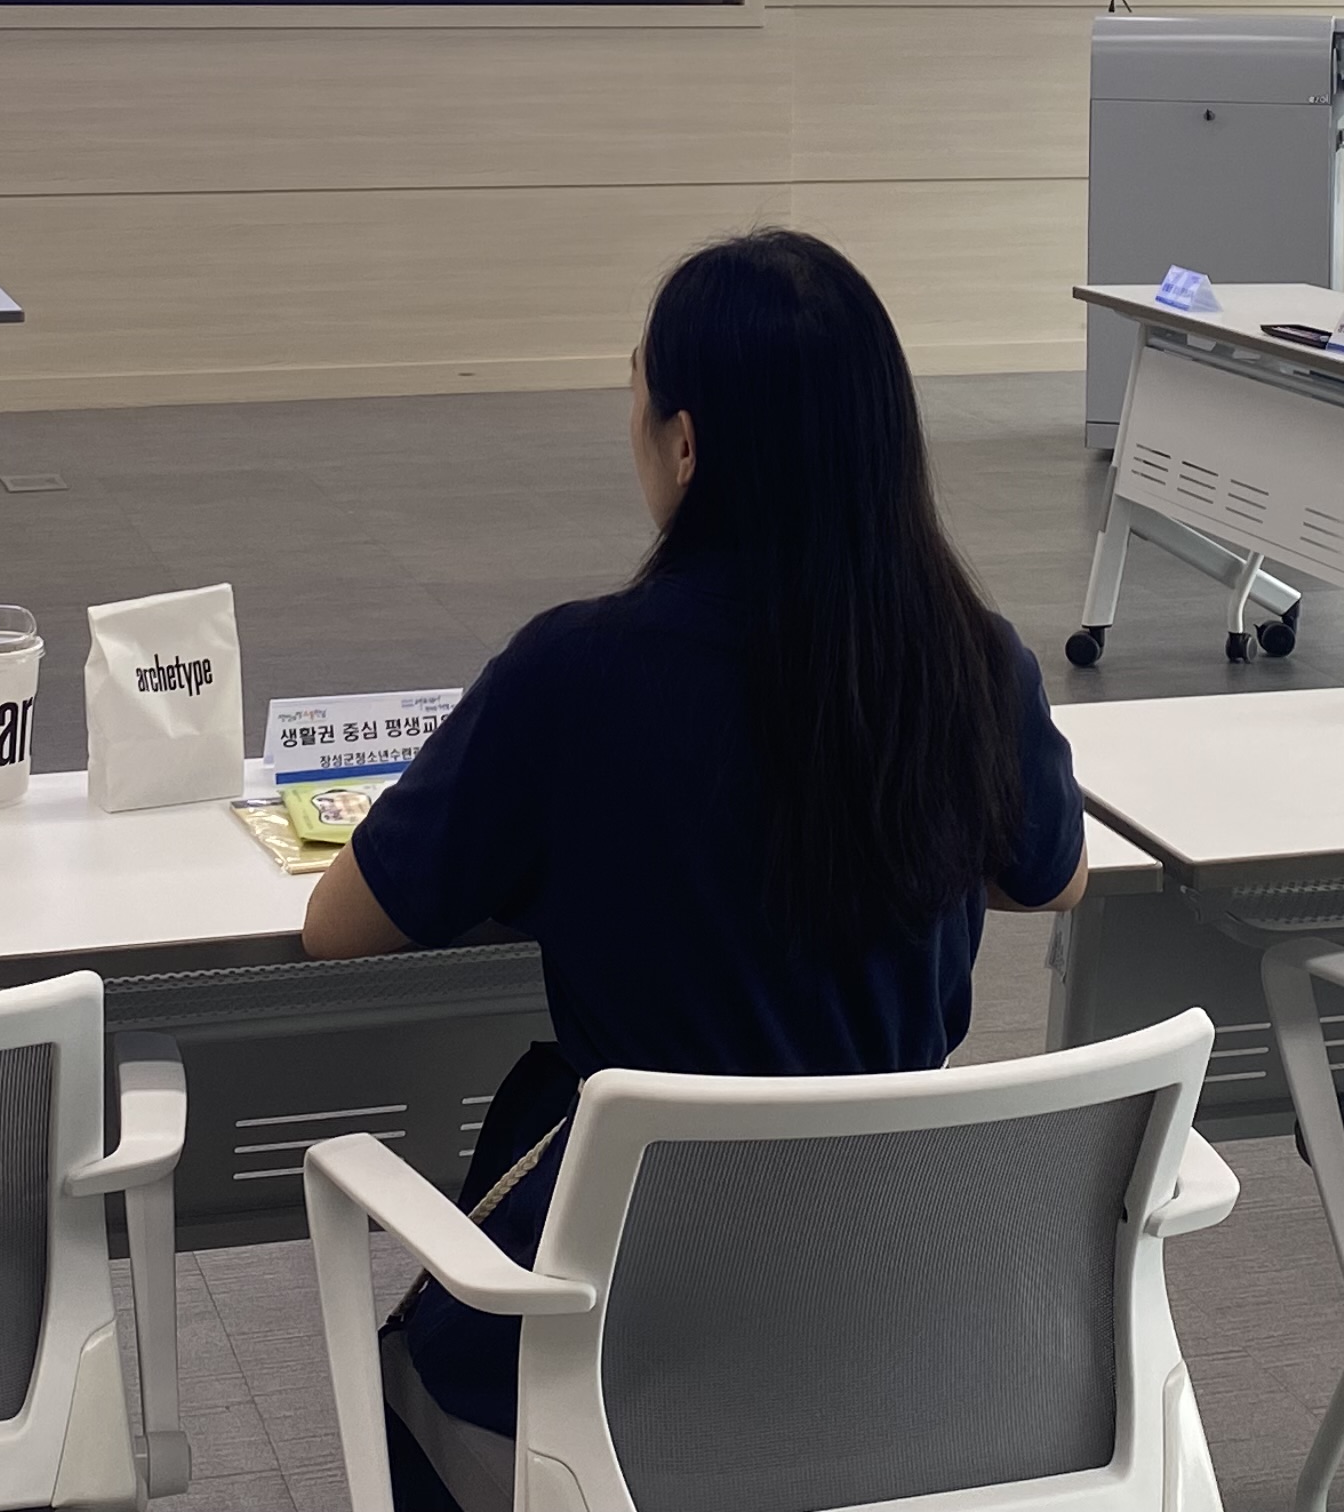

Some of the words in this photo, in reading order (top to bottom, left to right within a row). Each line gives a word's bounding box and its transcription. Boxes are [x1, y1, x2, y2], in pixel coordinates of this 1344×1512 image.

[136, 653, 213, 697] archetype
[280, 724, 336, 748] 생활권
[342, 719, 378, 742] 중심
